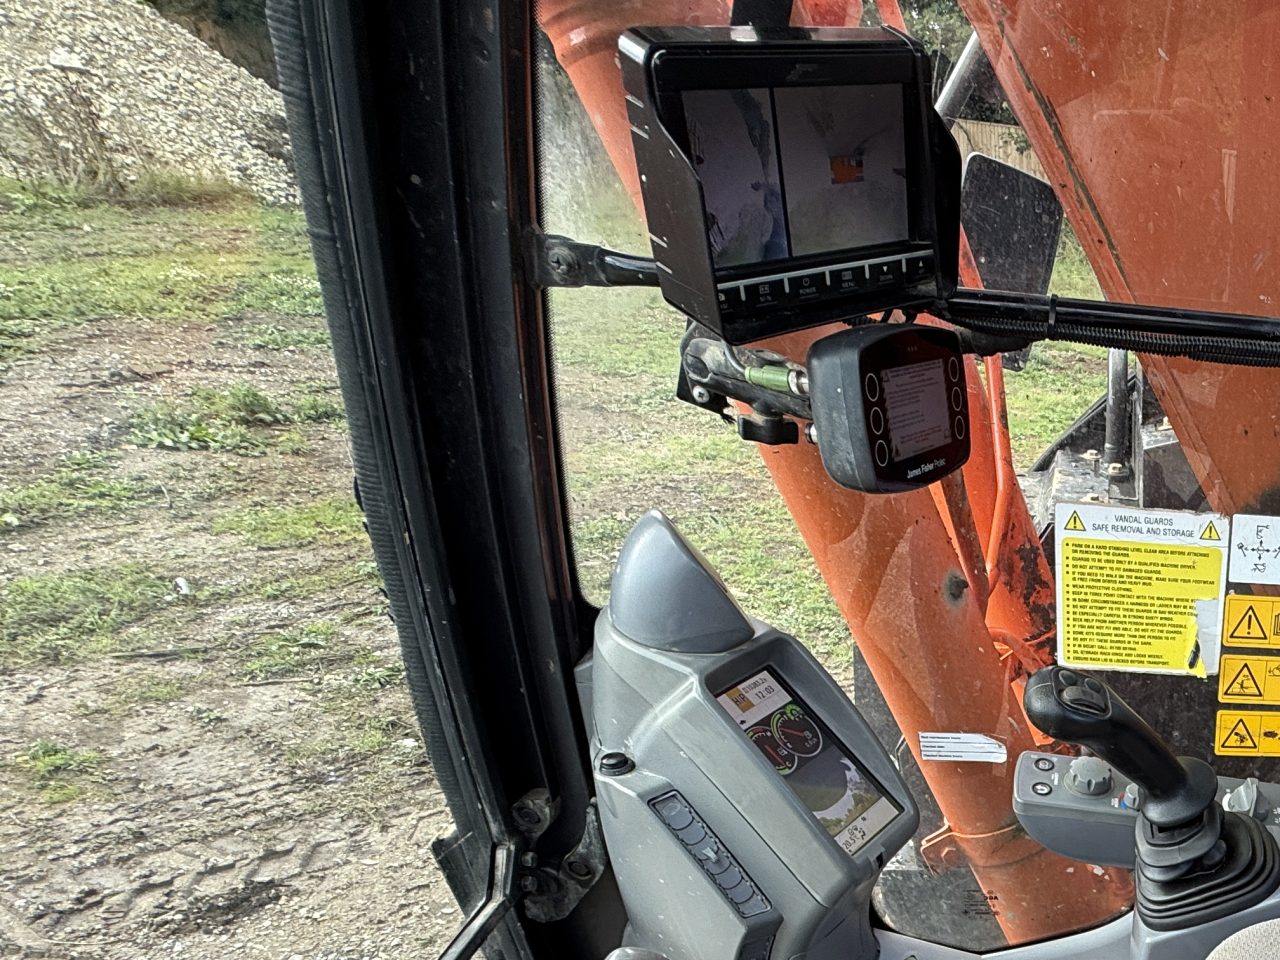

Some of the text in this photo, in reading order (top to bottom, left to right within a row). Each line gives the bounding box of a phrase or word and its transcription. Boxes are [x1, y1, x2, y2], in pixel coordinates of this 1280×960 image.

[1115, 515, 1174, 526] VANDAL GUARDS
[1092, 524, 1194, 537] SAFE REMOVAL AND STORAGE
[755, 686, 774, 699] 12:03
